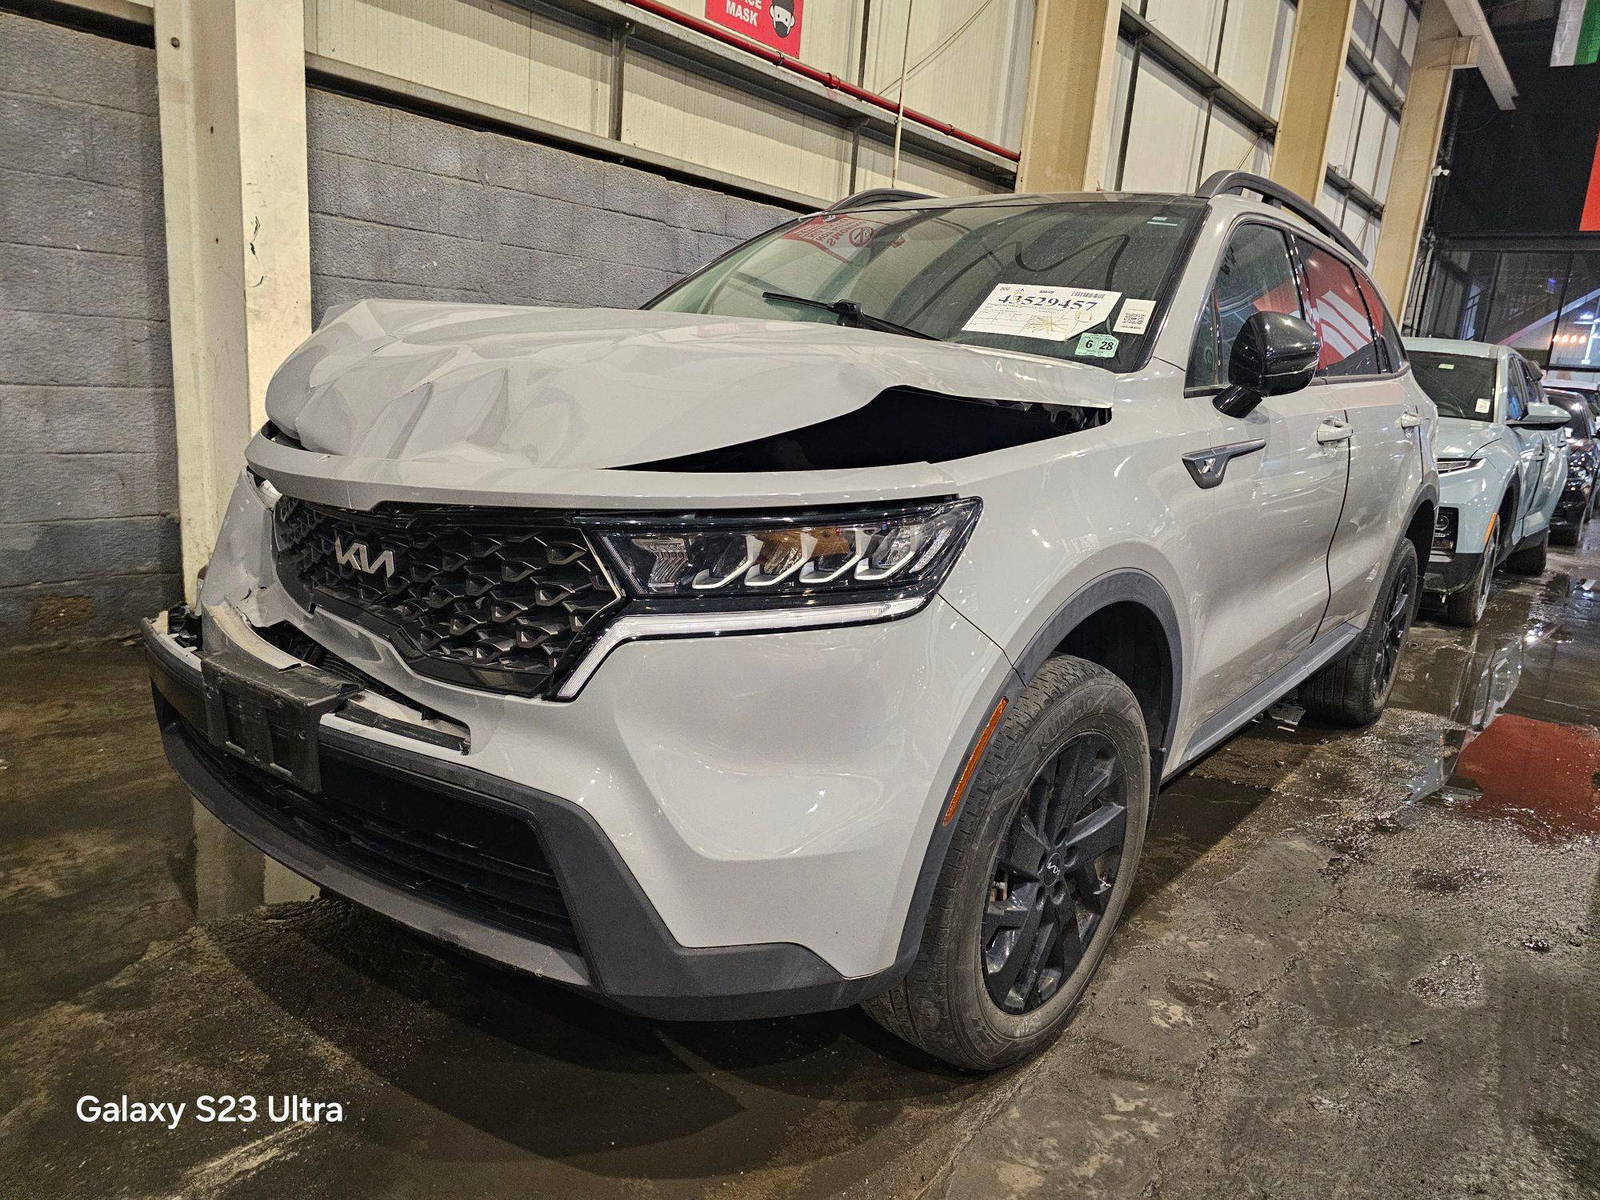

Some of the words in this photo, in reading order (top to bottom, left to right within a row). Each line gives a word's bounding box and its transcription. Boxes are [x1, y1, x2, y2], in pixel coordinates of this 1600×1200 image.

[726, 0, 758, 26] MASK
[998, 294, 1098, 311] 43529457
[1085, 340, 1094, 349] 6
[1099, 341, 1114, 351] 28
[334, 536, 395, 578] KIA
